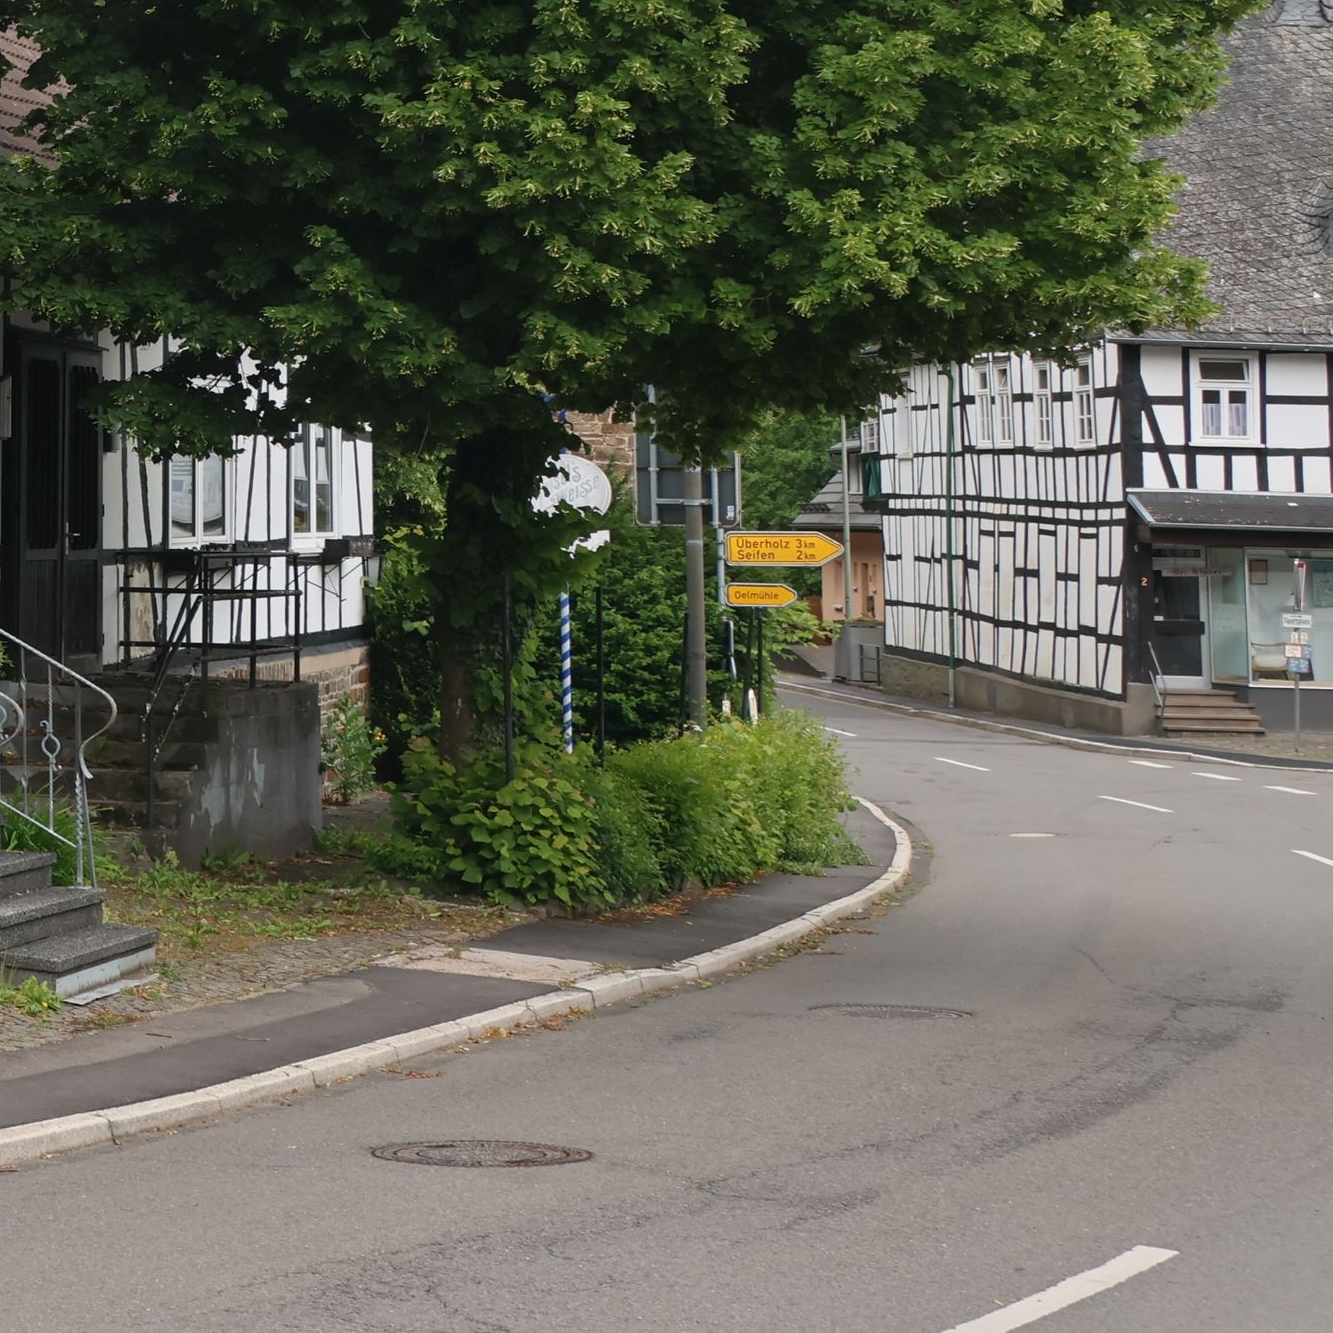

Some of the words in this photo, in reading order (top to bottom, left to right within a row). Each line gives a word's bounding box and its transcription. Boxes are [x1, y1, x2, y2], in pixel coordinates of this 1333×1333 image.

[736, 537, 789, 549] Überholz
[796, 539, 803, 548] 3
[804, 540, 816, 548] km
[737, 550, 775, 560] Seifen
[796, 550, 803, 560] 2
[804, 552, 816, 560] km
[1140, 577, 1148, 586] 2
[734, 591, 780, 600] Oelmühle
